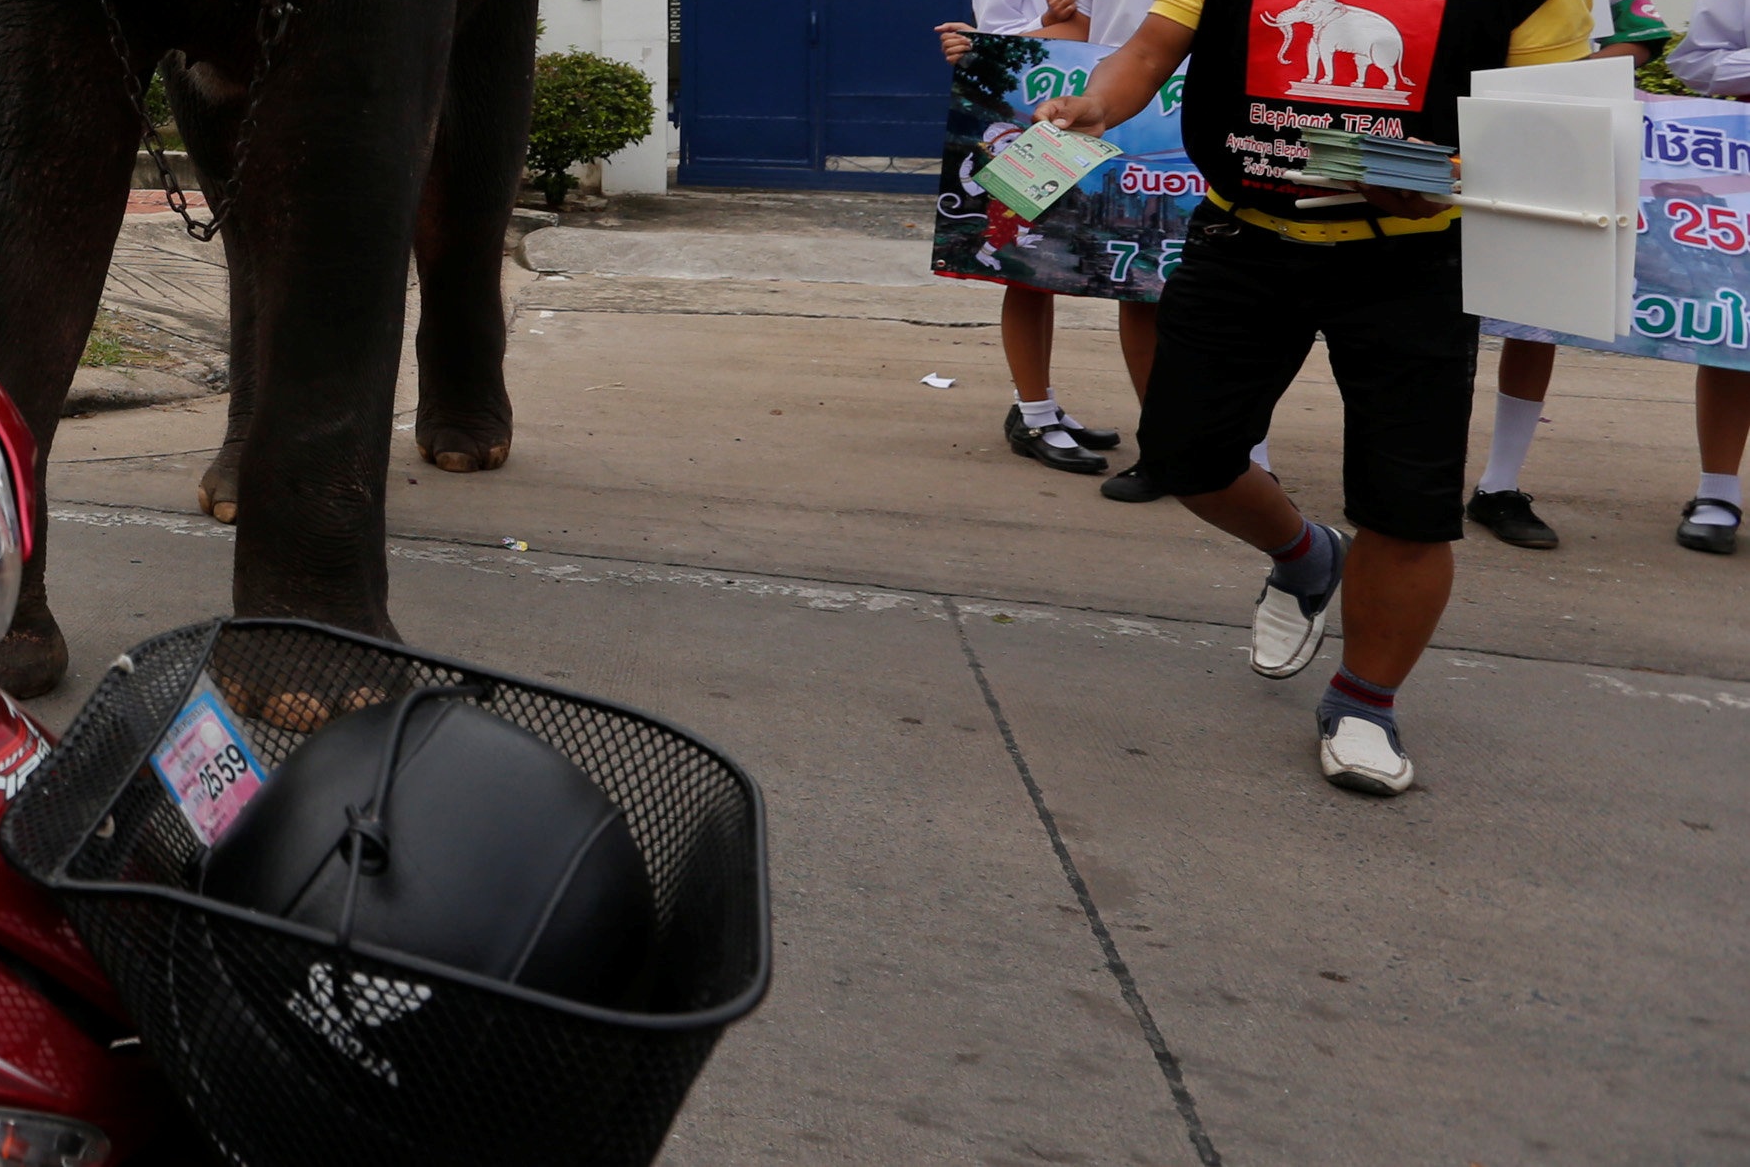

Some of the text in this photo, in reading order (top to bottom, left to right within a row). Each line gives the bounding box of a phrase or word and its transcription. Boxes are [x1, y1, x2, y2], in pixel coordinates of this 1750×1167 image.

[1249, 102, 1404, 139] Elephant TEAM
[1273, 138, 1311, 162] Elepha
[1121, 164, 1210, 194] วันอา
[1666, 199, 1750, 253] 25
[1109, 242, 1138, 280] 7
[1634, 289, 1750, 347] วมใ
[198, 743, 249, 802] 2559
